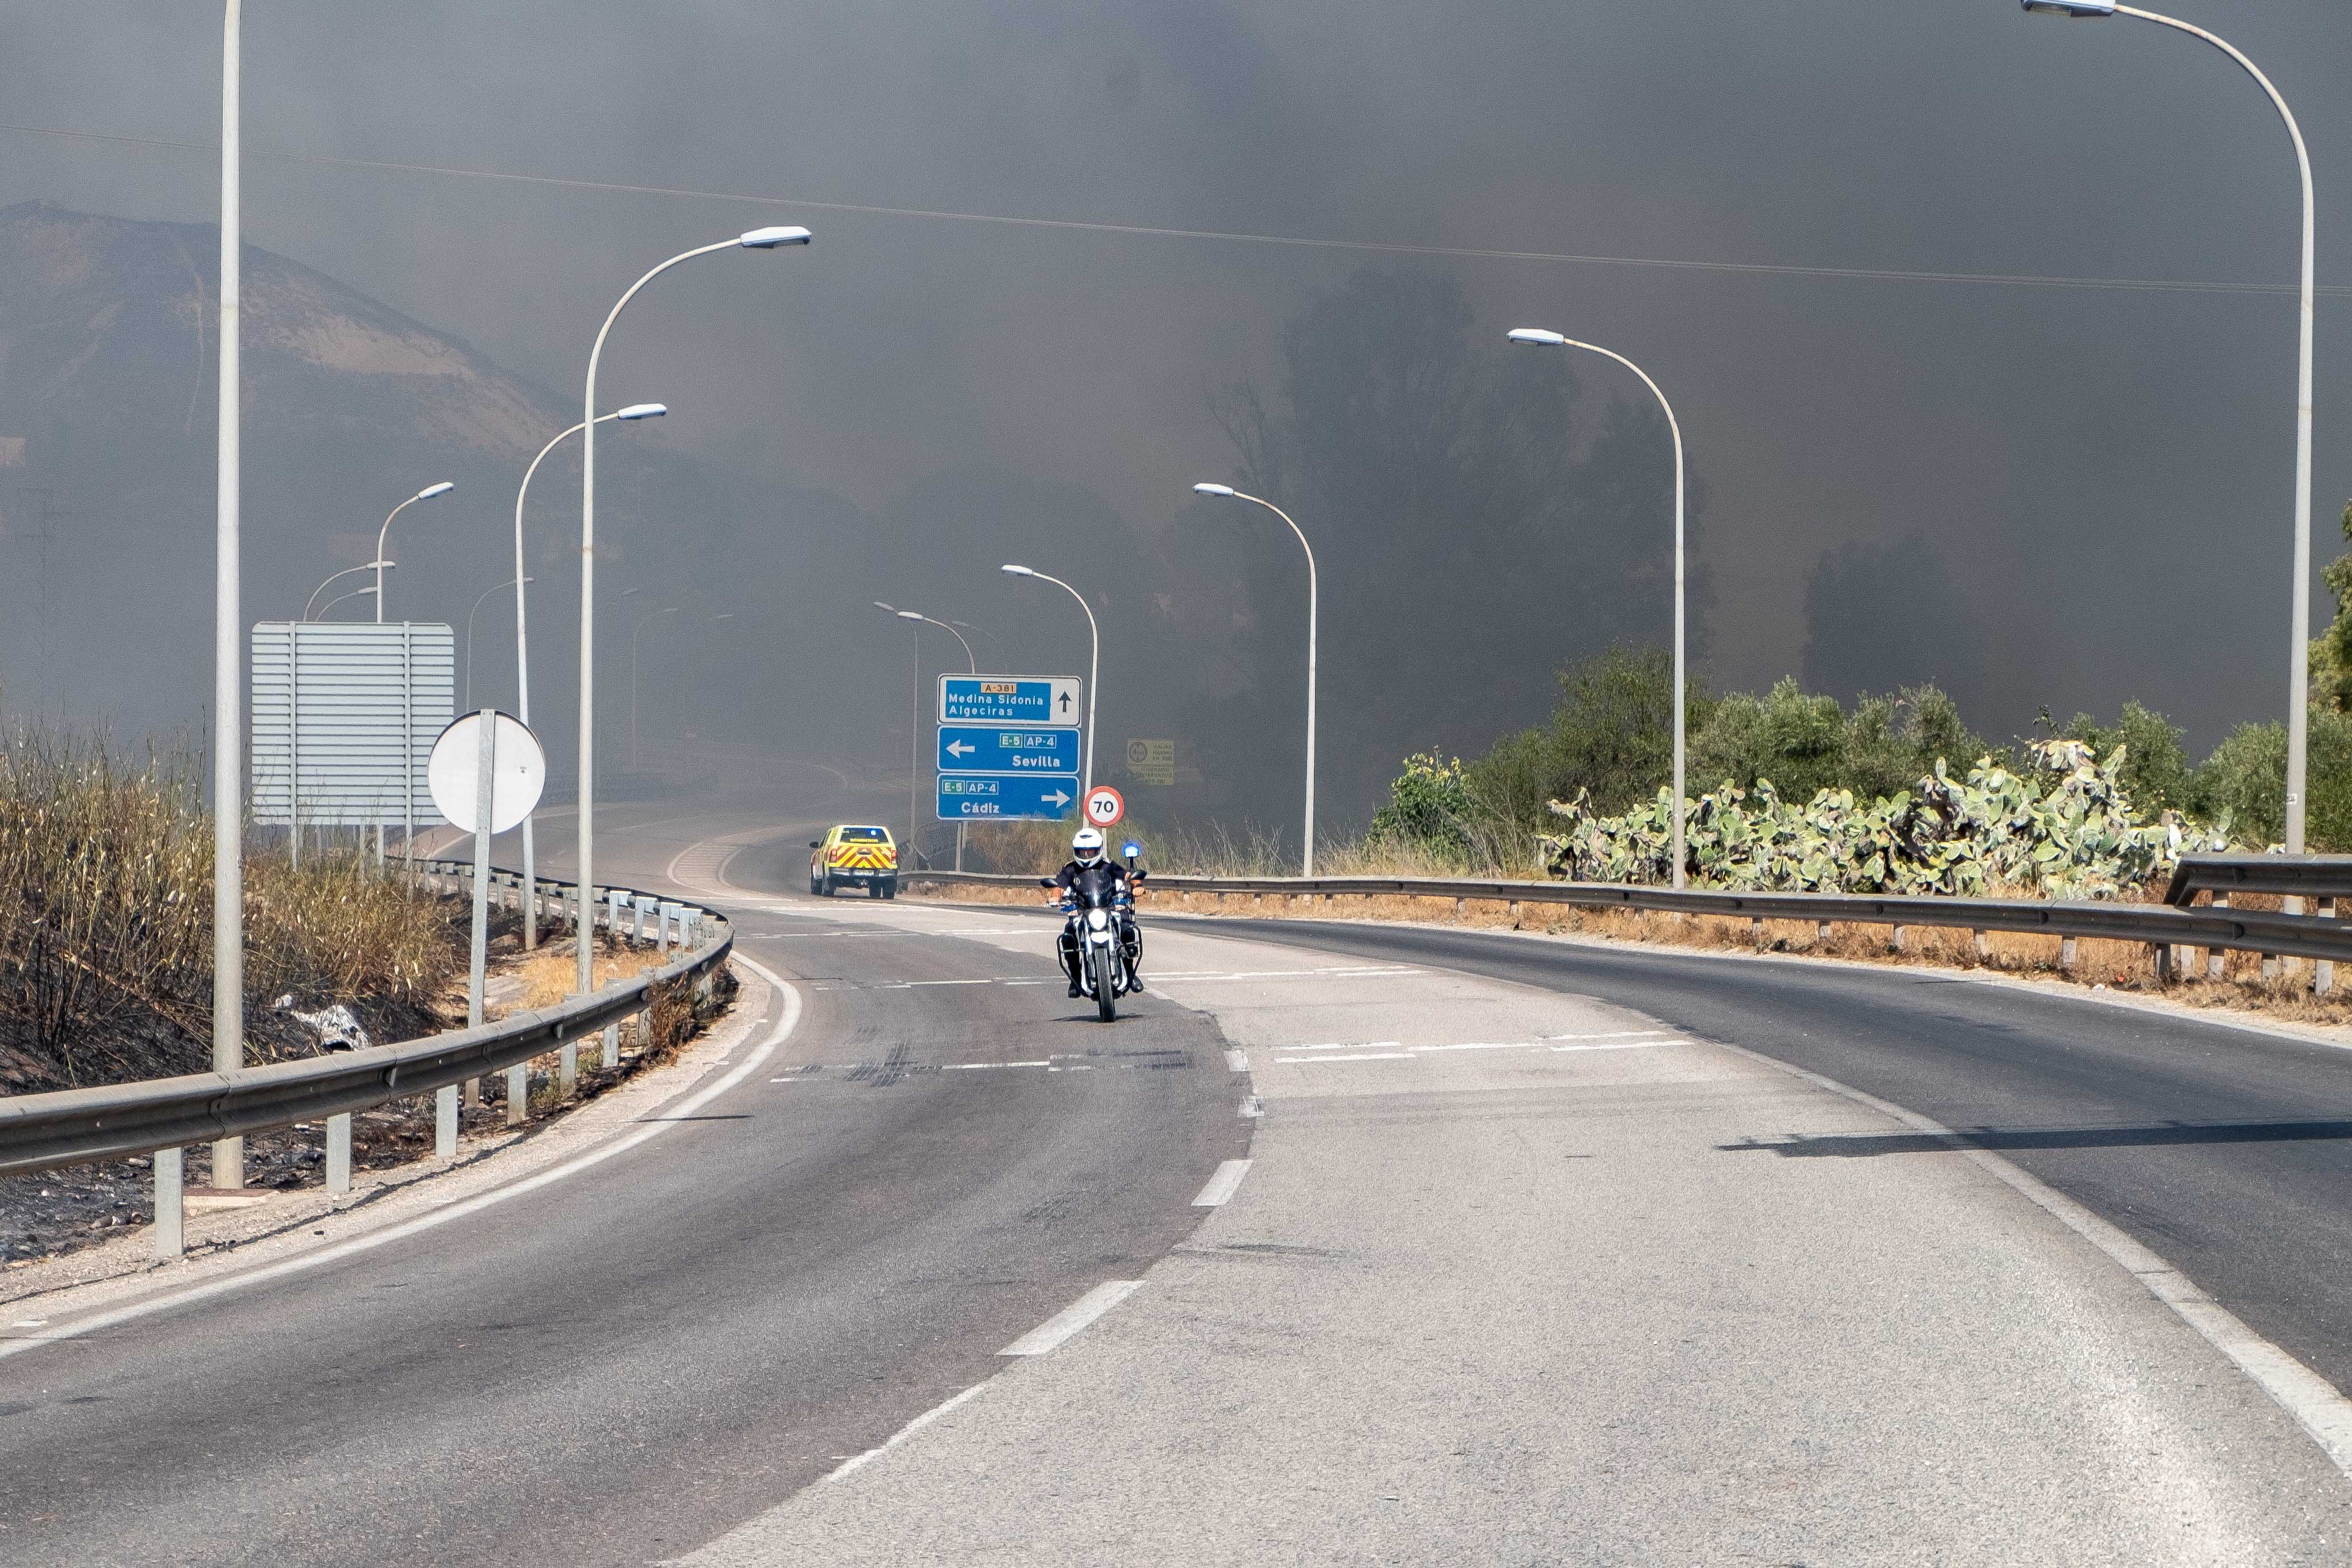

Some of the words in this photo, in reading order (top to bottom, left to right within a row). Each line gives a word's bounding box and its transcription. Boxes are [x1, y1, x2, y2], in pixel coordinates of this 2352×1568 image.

[949, 694, 992, 704] Medina
[998, 695, 1043, 705] Sidonia
[949, 706, 1013, 717] Algeciras
[1003, 736, 1020, 745] E-5
[1027, 737, 1054, 746] AP-4
[1012, 754, 1060, 767] Sevilla
[944, 782, 963, 792] E-5
[968, 783, 996, 793] AP-4
[961, 801, 999, 814] Cádiz
[1094, 801, 1114, 813] 70
